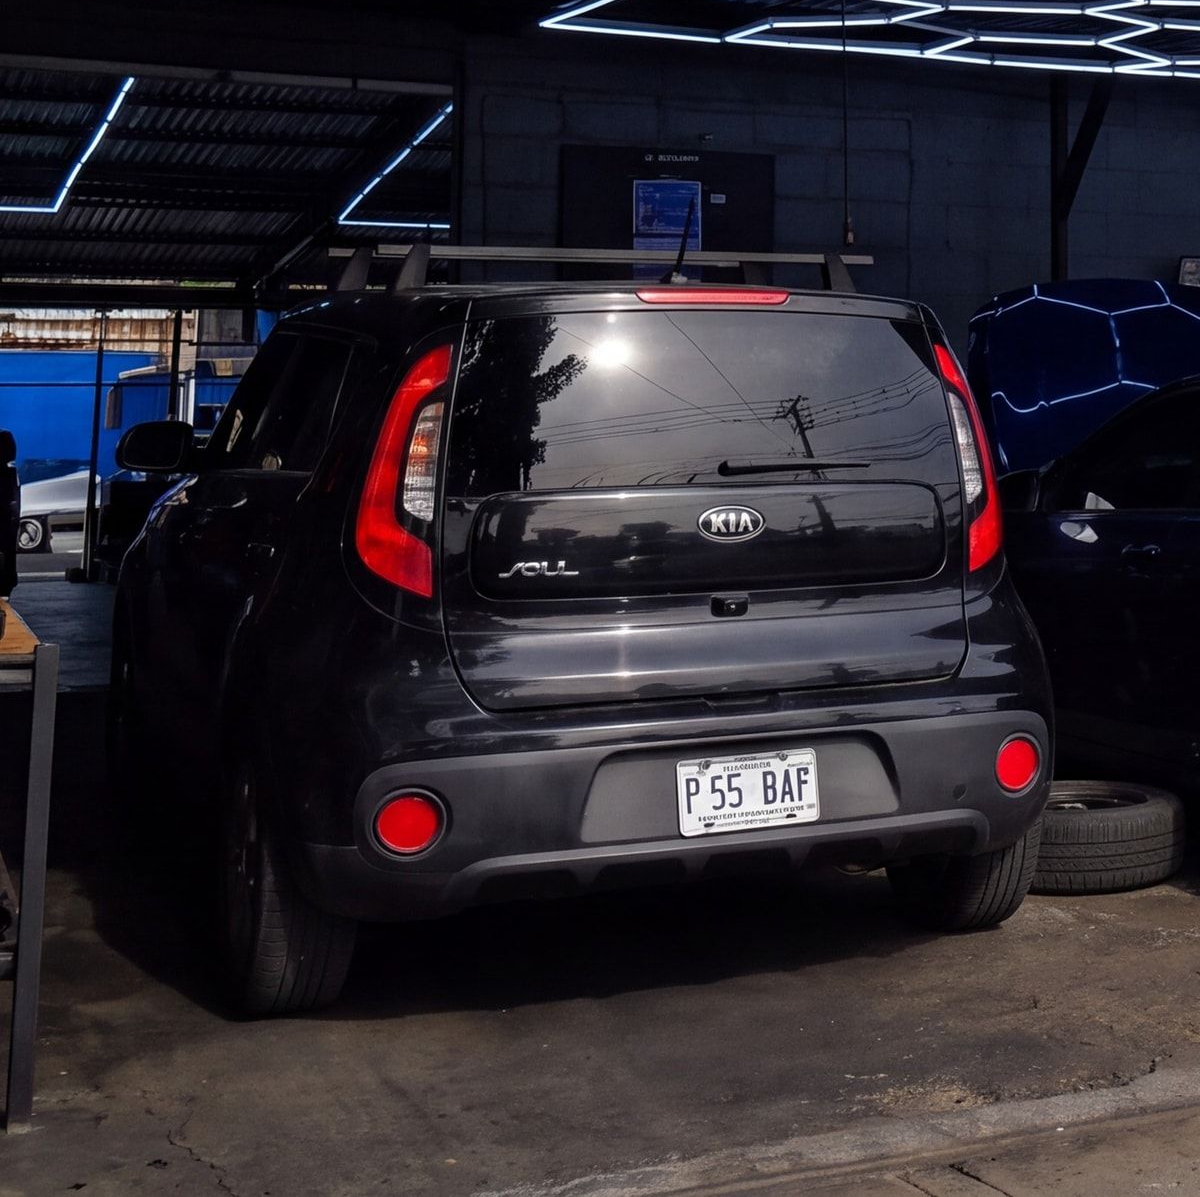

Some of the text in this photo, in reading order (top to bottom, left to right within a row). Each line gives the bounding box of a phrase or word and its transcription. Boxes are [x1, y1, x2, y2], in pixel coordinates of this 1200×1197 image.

[710, 512, 754, 533] KIA
[685, 777, 700, 814] P
[711, 773, 743, 810] 55
[762, 767, 809, 805] BAF
